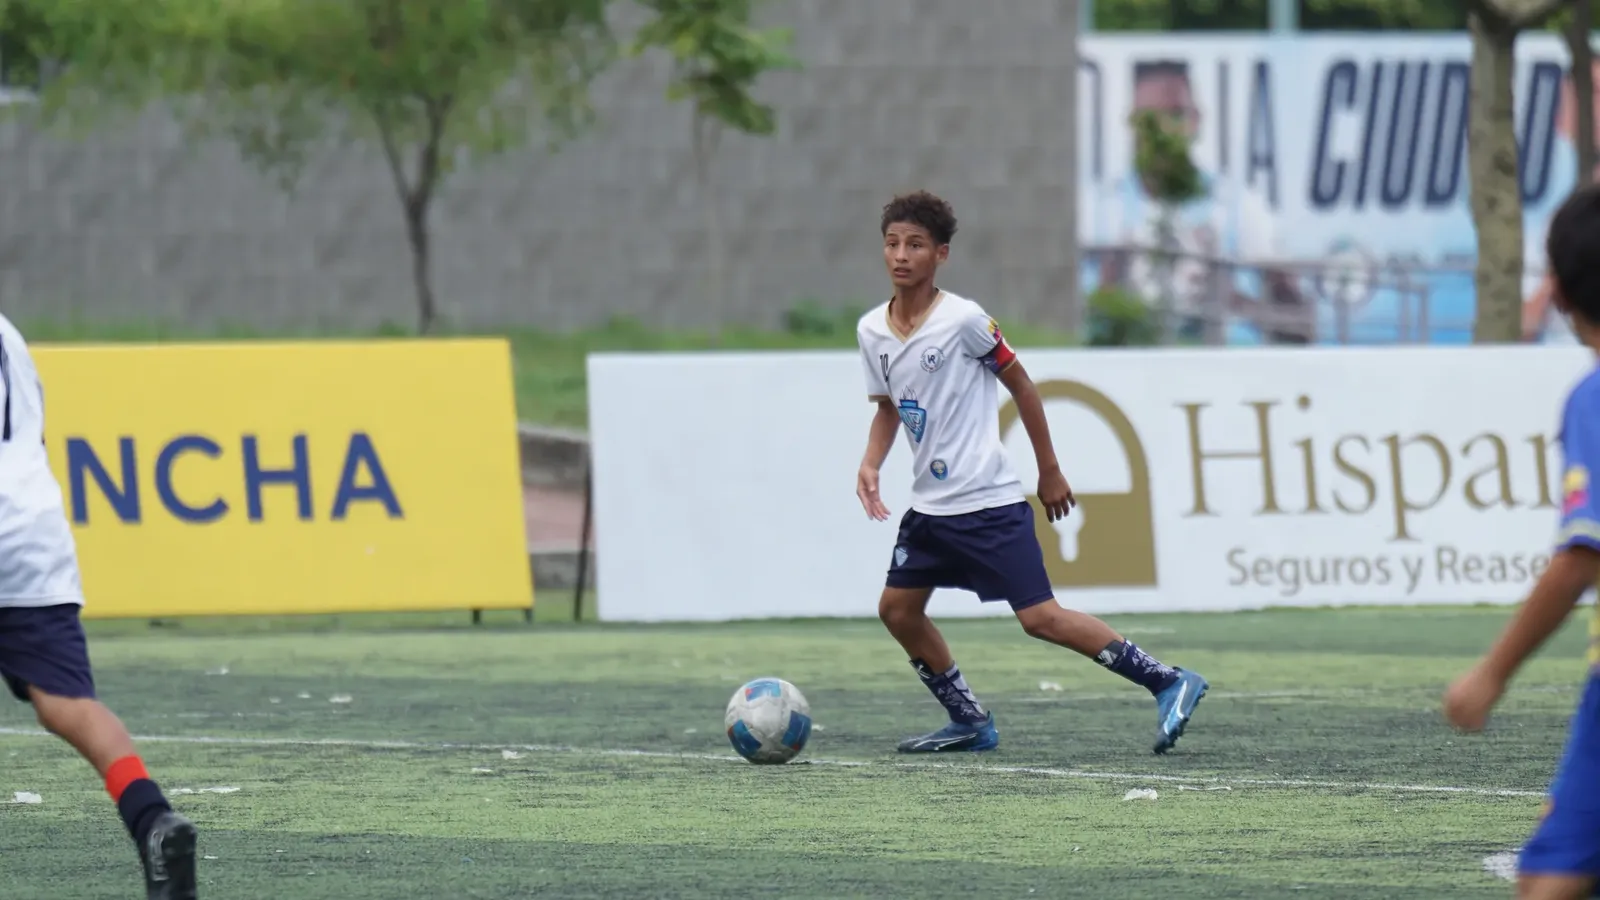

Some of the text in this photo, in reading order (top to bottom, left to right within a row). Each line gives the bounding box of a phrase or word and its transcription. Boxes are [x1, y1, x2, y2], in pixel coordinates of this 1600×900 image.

[1310, 60, 1562, 207] CIUDD
[66, 432, 405, 525] NCHA
[1226, 546, 1391, 596] Seguros
[1402, 557, 1424, 595] y
